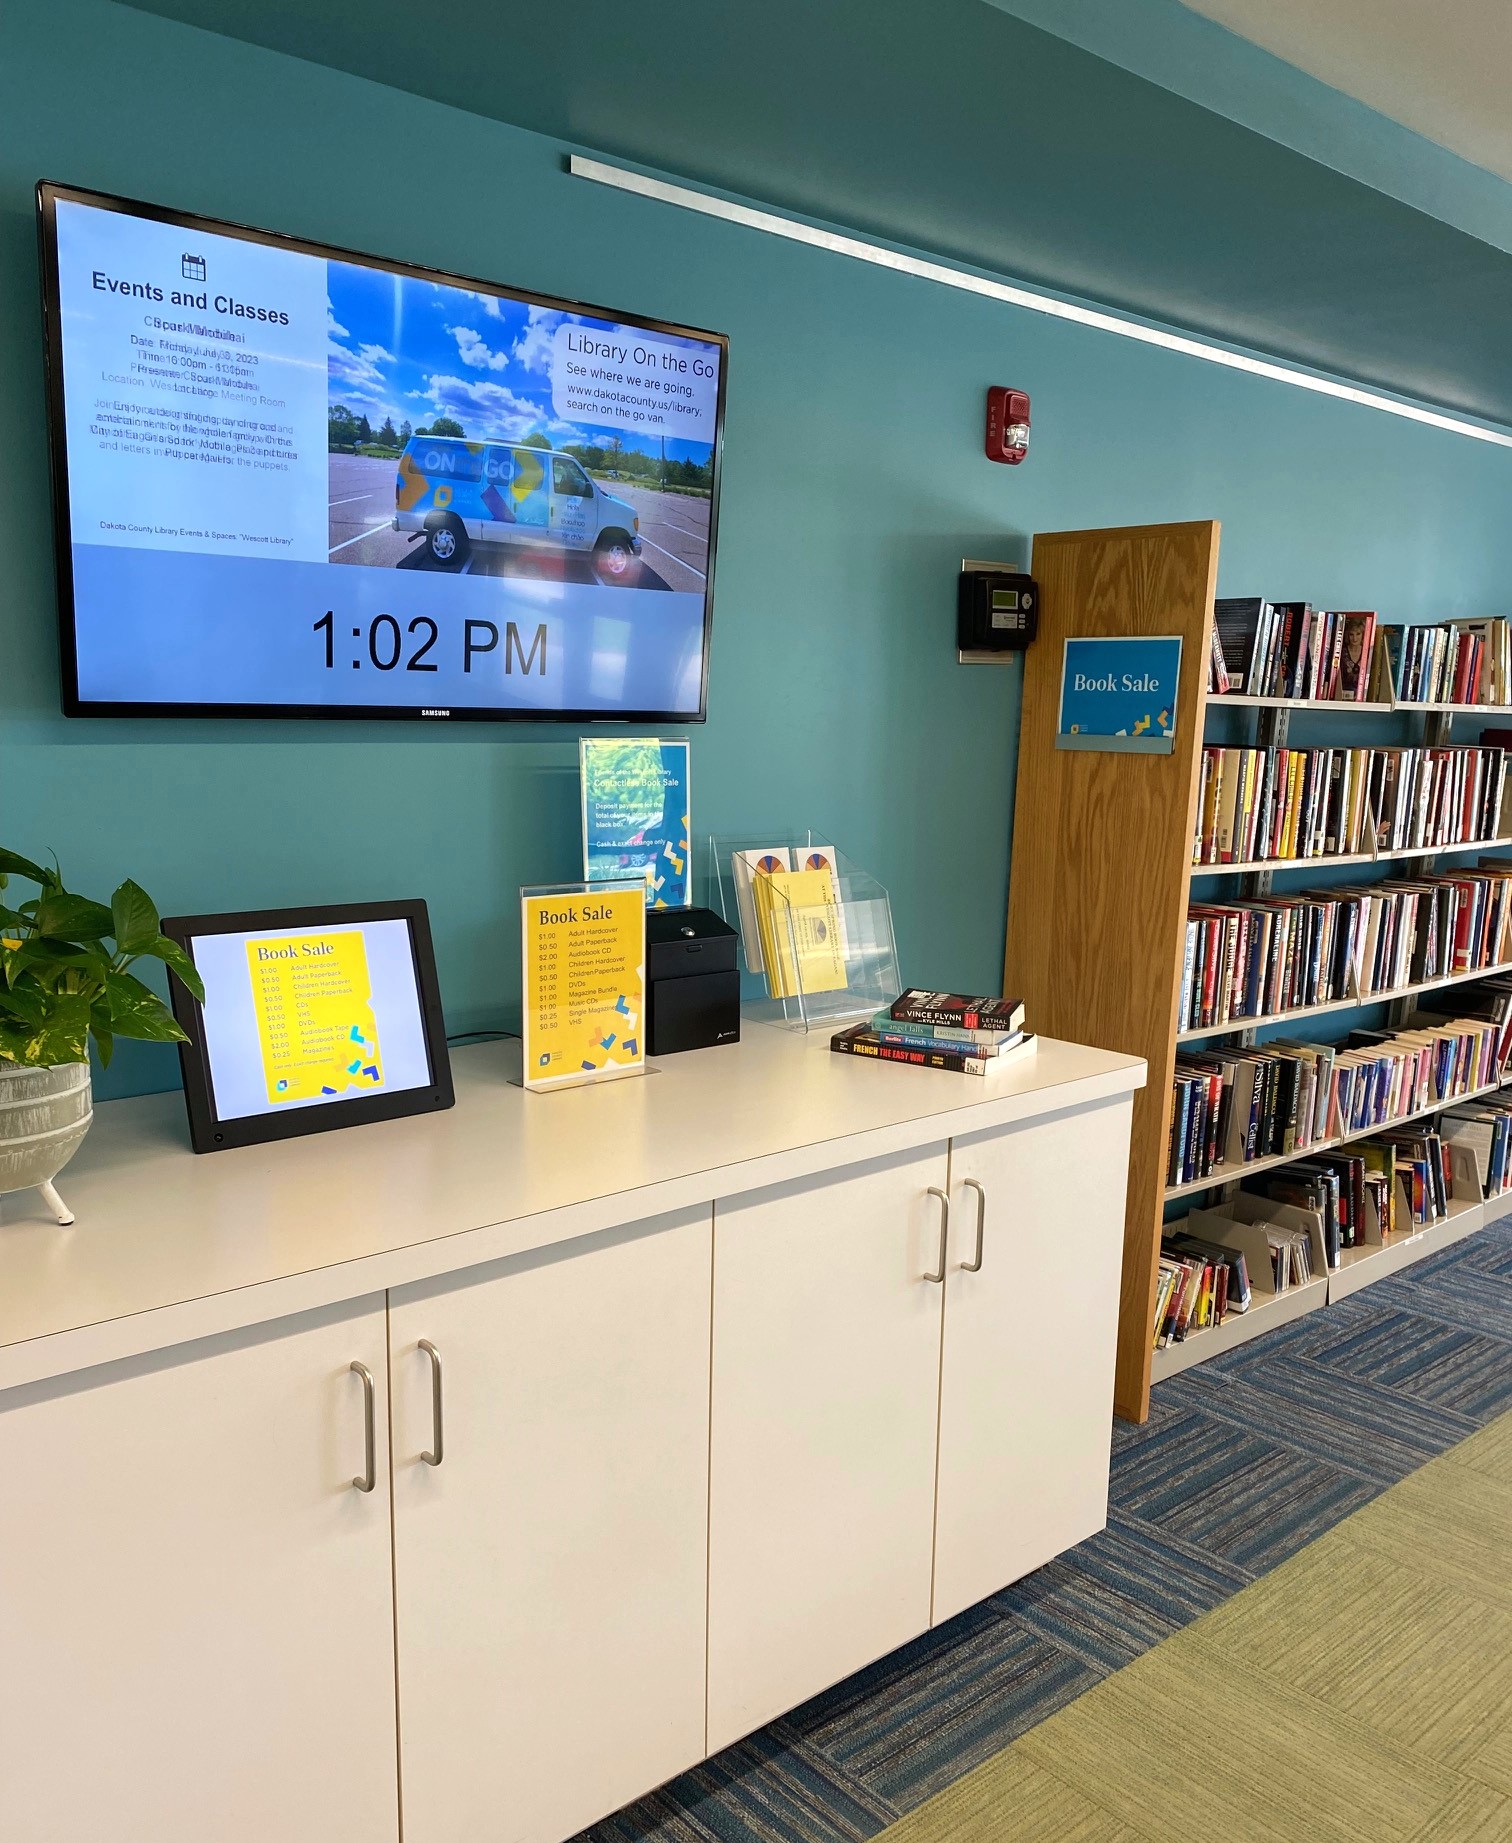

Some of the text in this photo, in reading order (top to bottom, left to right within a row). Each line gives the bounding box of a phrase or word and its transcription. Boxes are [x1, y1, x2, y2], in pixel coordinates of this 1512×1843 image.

[93, 271, 289, 325] Events and Classes
[568, 333, 714, 378] Library On the Go
[566, 361, 695, 398] See where we are going.
[567, 399, 666, 424] search on the go van.
[424, 451, 514, 480] ON GO
[100, 521, 127, 532] Dakota
[128, 524, 153, 534] County
[155, 525, 178, 536] Library
[180, 528, 203, 538] Events
[1285, 612, 1293, 647] ROBERT
[313, 610, 547, 676] 1:02 PM
[1074, 673, 1159, 692] Book Sale
[421, 709, 450, 717] SAMSUNG
[594, 778, 679, 787] Contactless Book Sale
[539, 905, 613, 925] Book Sale
[539, 926, 619, 941] $1.00 Adult Hardcover
[1272, 914, 1282, 962] ADRENALINE
[539, 936, 618, 951] $0.50 Adult Paperback
[1226, 924, 1237, 973] THE JUDGE
[1287, 931, 1296, 965] MAZE
[257, 942, 334, 961] Book Sale
[539, 947, 612, 961] $2.00 Audiobook CD
[260, 961, 339, 975] $1.00 Adult Hardcover
[539, 956, 625, 972] $1.00 Children Hardcover
[262, 970, 342, 984] $0.50 Adult Paperback
[539, 965, 625, 982] $0.50 Children Paperback
[293, 982, 319, 990] Children
[320, 978, 351, 987] Hardcover
[539, 980, 586, 992] $1.00 DVDs
[264, 988, 353, 1003] $0.50 Children Paperback
[539, 986, 618, 1002] $1.00 Magazine Bundle
[266, 1004, 283, 1012] $1.00
[539, 997, 599, 1011] $1.00 Music CDs
[267, 1014, 286, 1022] $0.50
[539, 1008, 587, 1021] $0.25 Single
[907, 1010, 962, 1021] VINCE FLYNN
[981, 1017, 1007, 1025] LETHAL
[269, 1023, 286, 1031] $1.00
[539, 1018, 582, 1031] $0.50 VHS
[889, 1024, 924, 1033] angel falls
[270, 1032, 288, 1040] $0.50
[301, 1027, 333, 1036] Audiobook
[271, 1041, 290, 1049] $2.00
[302, 1036, 334, 1045] Audiobook
[905, 1038, 926, 1046] French
[927, 1040, 960, 1051] Vocabulary
[273, 1046, 335, 1059] $0.25 Magazines
[853, 1044, 878, 1055] FRENCH
[879, 1048, 891, 1058] THE
[892, 1050, 909, 1060] EASY
[910, 1053, 925, 1062] WAY
[1252, 1072, 1264, 1105] Silva
[1271, 1084, 1279, 1115] BALDACCI
[1291, 1082, 1300, 1114] BALDACCI
[1179, 1085, 1191, 1157] JOHN SANDFORD
[1247, 1122, 1258, 1150] Cellist
